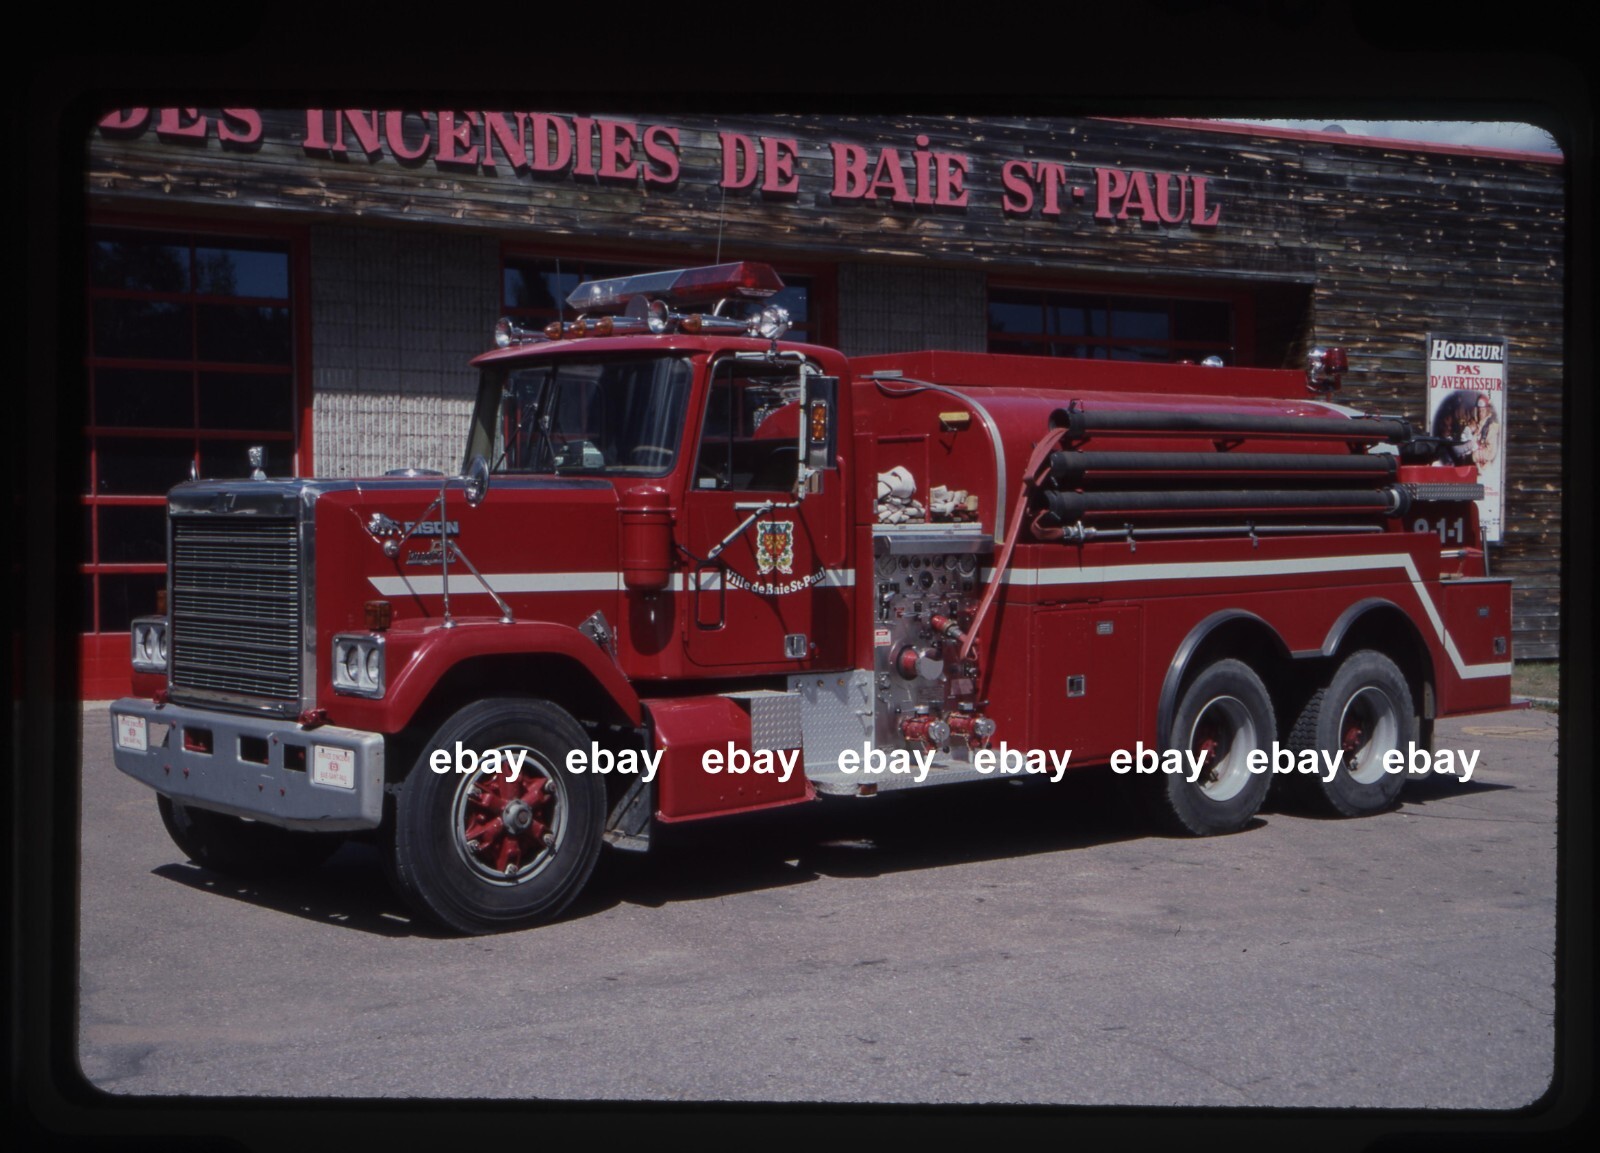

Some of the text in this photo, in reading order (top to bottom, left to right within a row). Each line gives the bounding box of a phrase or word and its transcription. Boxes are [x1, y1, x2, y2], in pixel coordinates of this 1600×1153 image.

[303, 109, 680, 184] INCENDIES
[719, 132, 799, 193] DE
[1002, 159, 1220, 226] ST-PAUL
[1431, 340, 1504, 360] HORREUR!
[1456, 364, 1481, 375] PAS
[1430, 375, 1503, 391] D'AVERTISSEUR
[725, 566, 827, 595] Ville de Baie St-Paul
